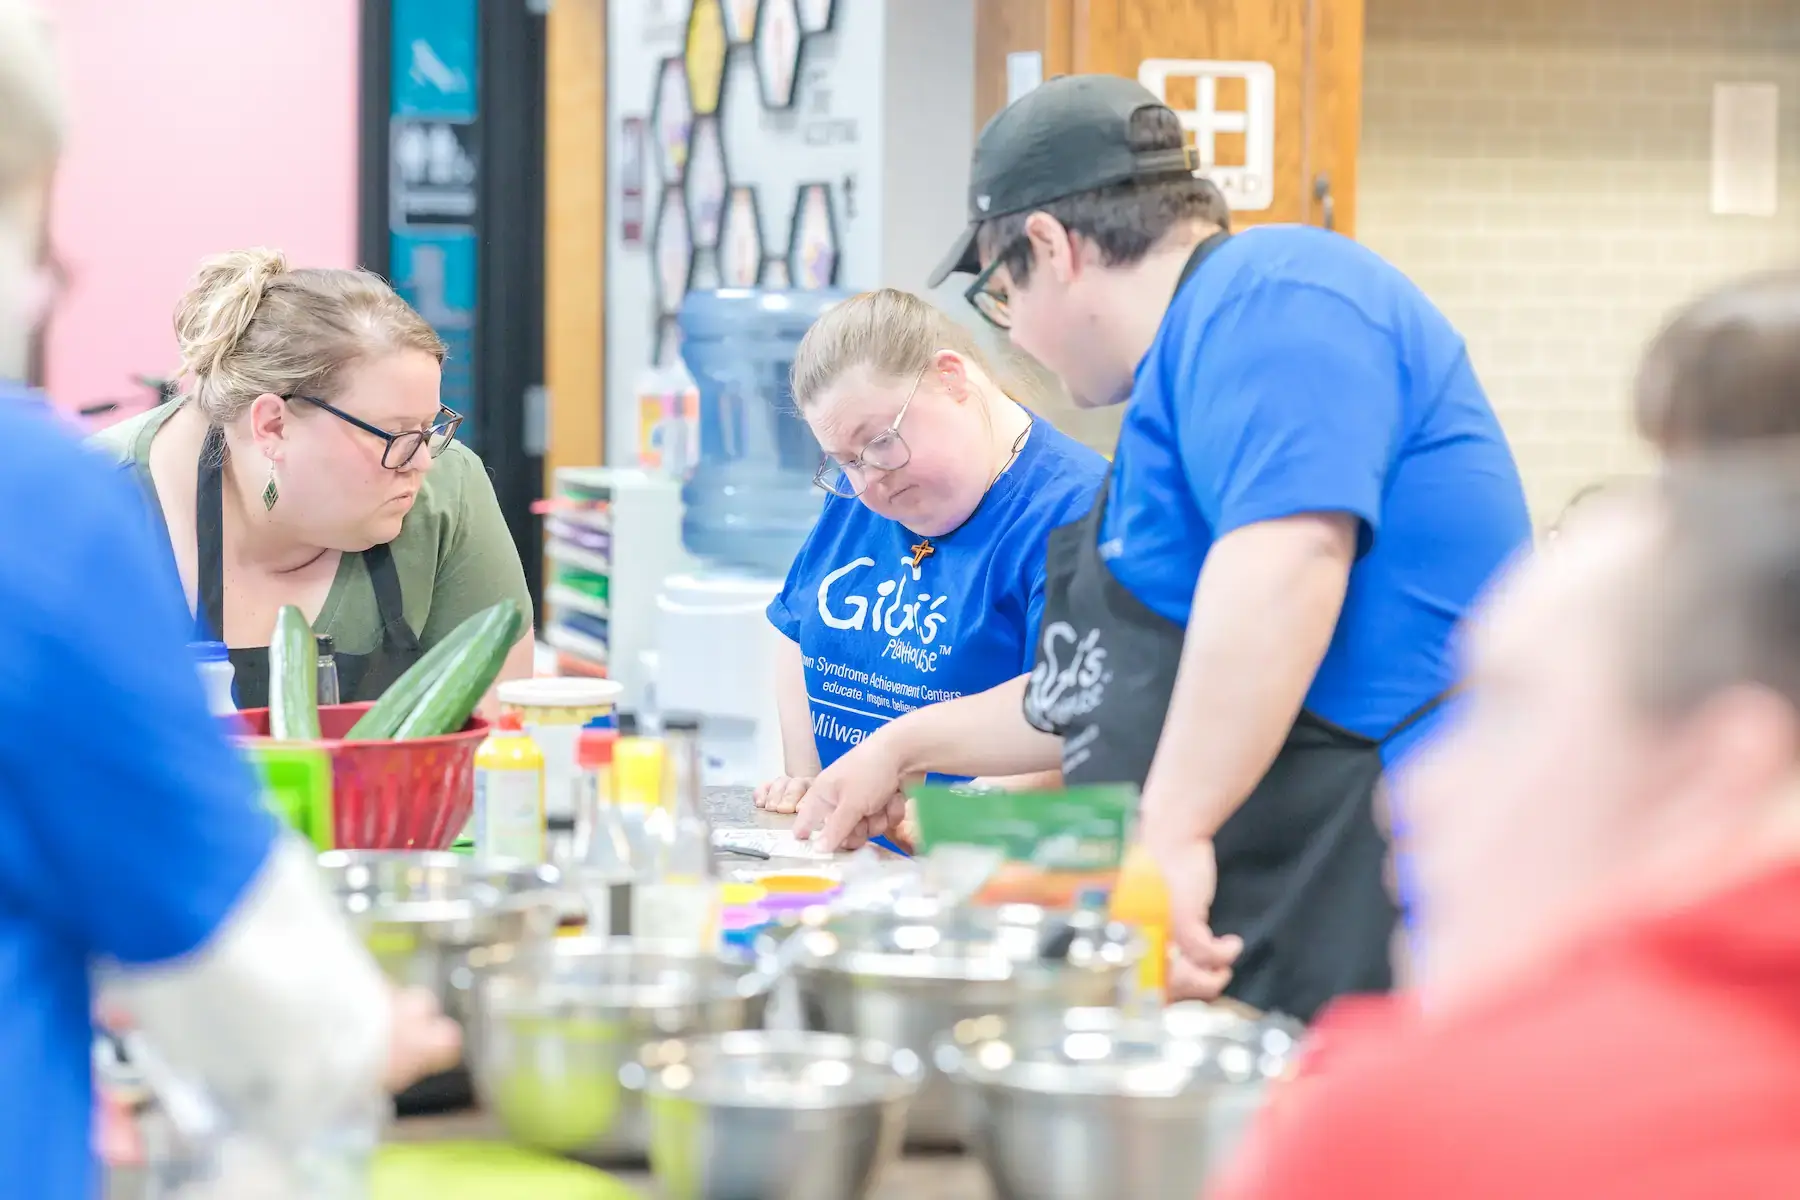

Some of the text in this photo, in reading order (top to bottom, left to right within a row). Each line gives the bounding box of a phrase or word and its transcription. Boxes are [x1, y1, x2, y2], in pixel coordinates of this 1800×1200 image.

[816, 656, 869, 684] Syndrome
[870, 672, 920, 699] Achievement
[822, 681, 864, 701] educate.
[866, 690, 892, 708] inspire.
